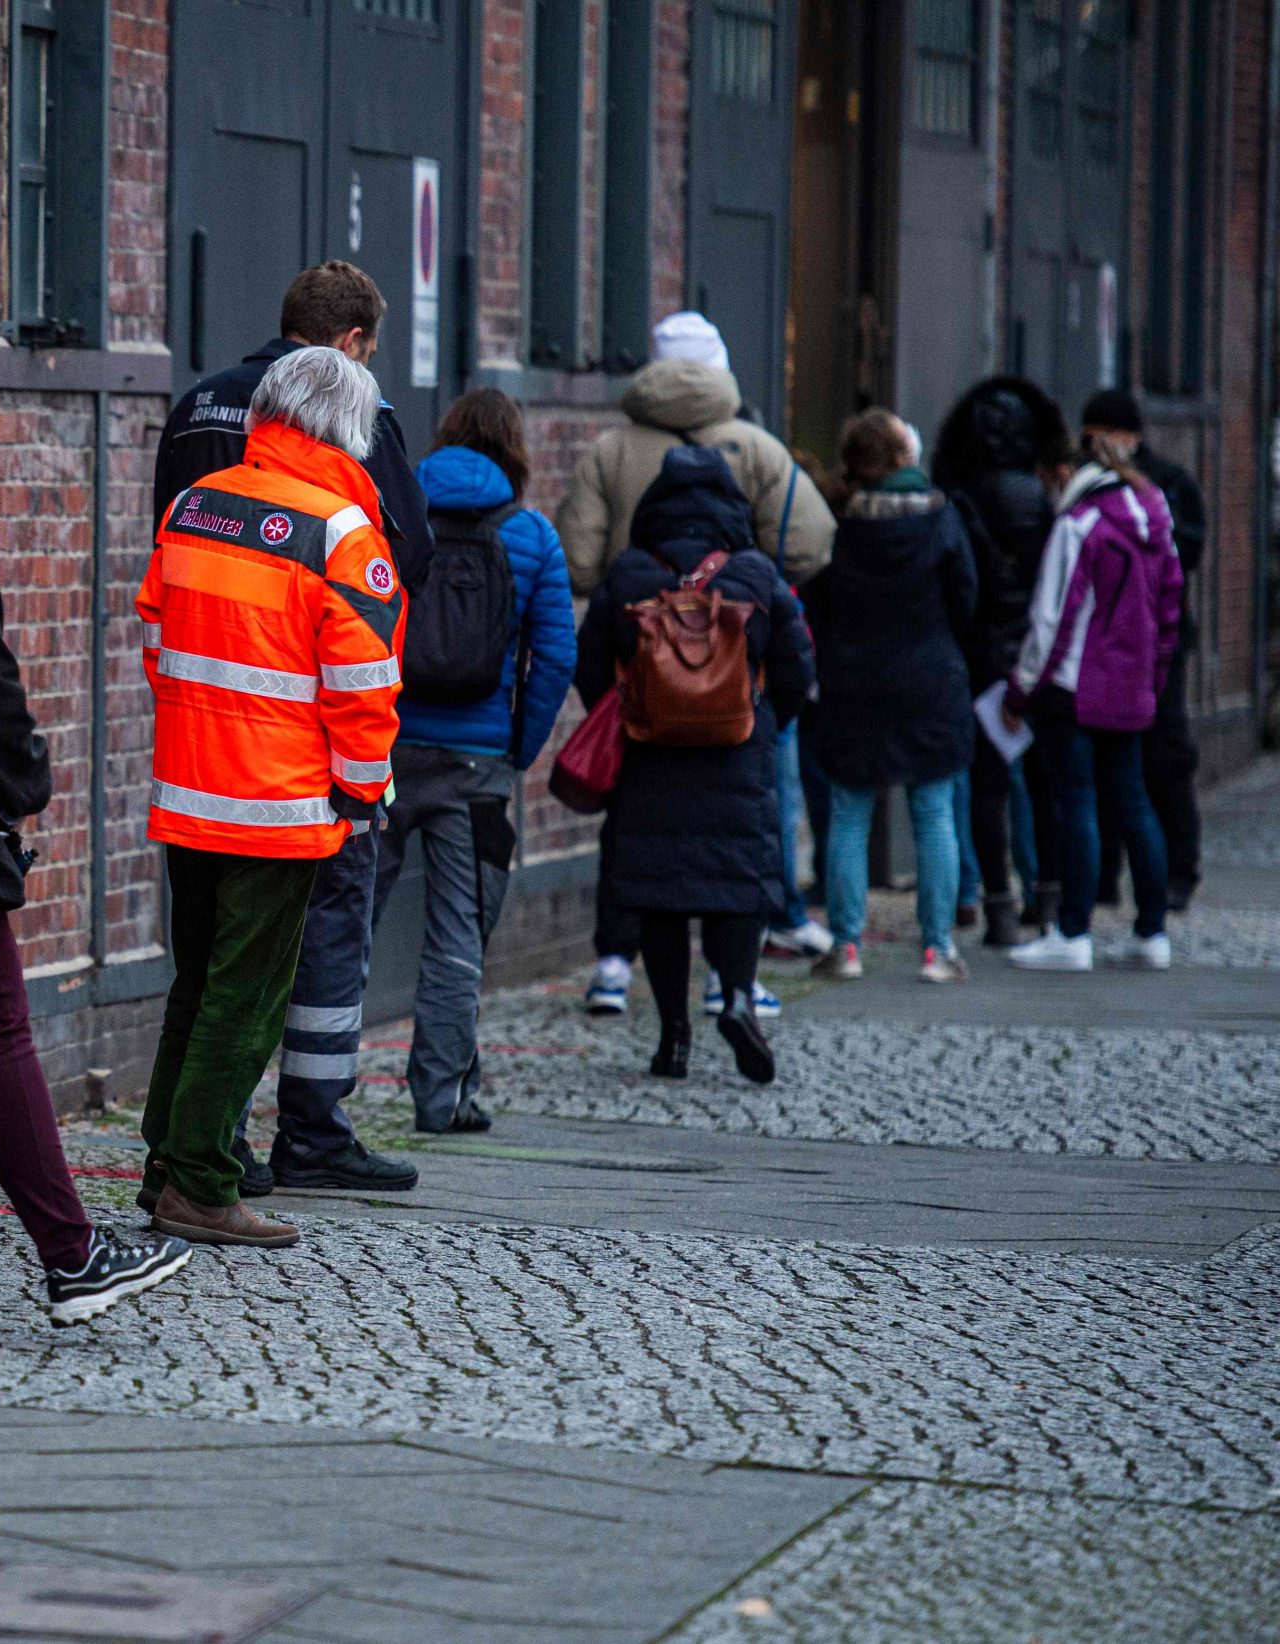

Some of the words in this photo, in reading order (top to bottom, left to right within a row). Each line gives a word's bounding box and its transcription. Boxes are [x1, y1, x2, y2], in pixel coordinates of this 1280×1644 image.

[349, 184, 362, 251] 5
[195, 391, 215, 406] DIE
[185, 494, 204, 509] DIE
[176, 510, 244, 537] JOHANNITER
